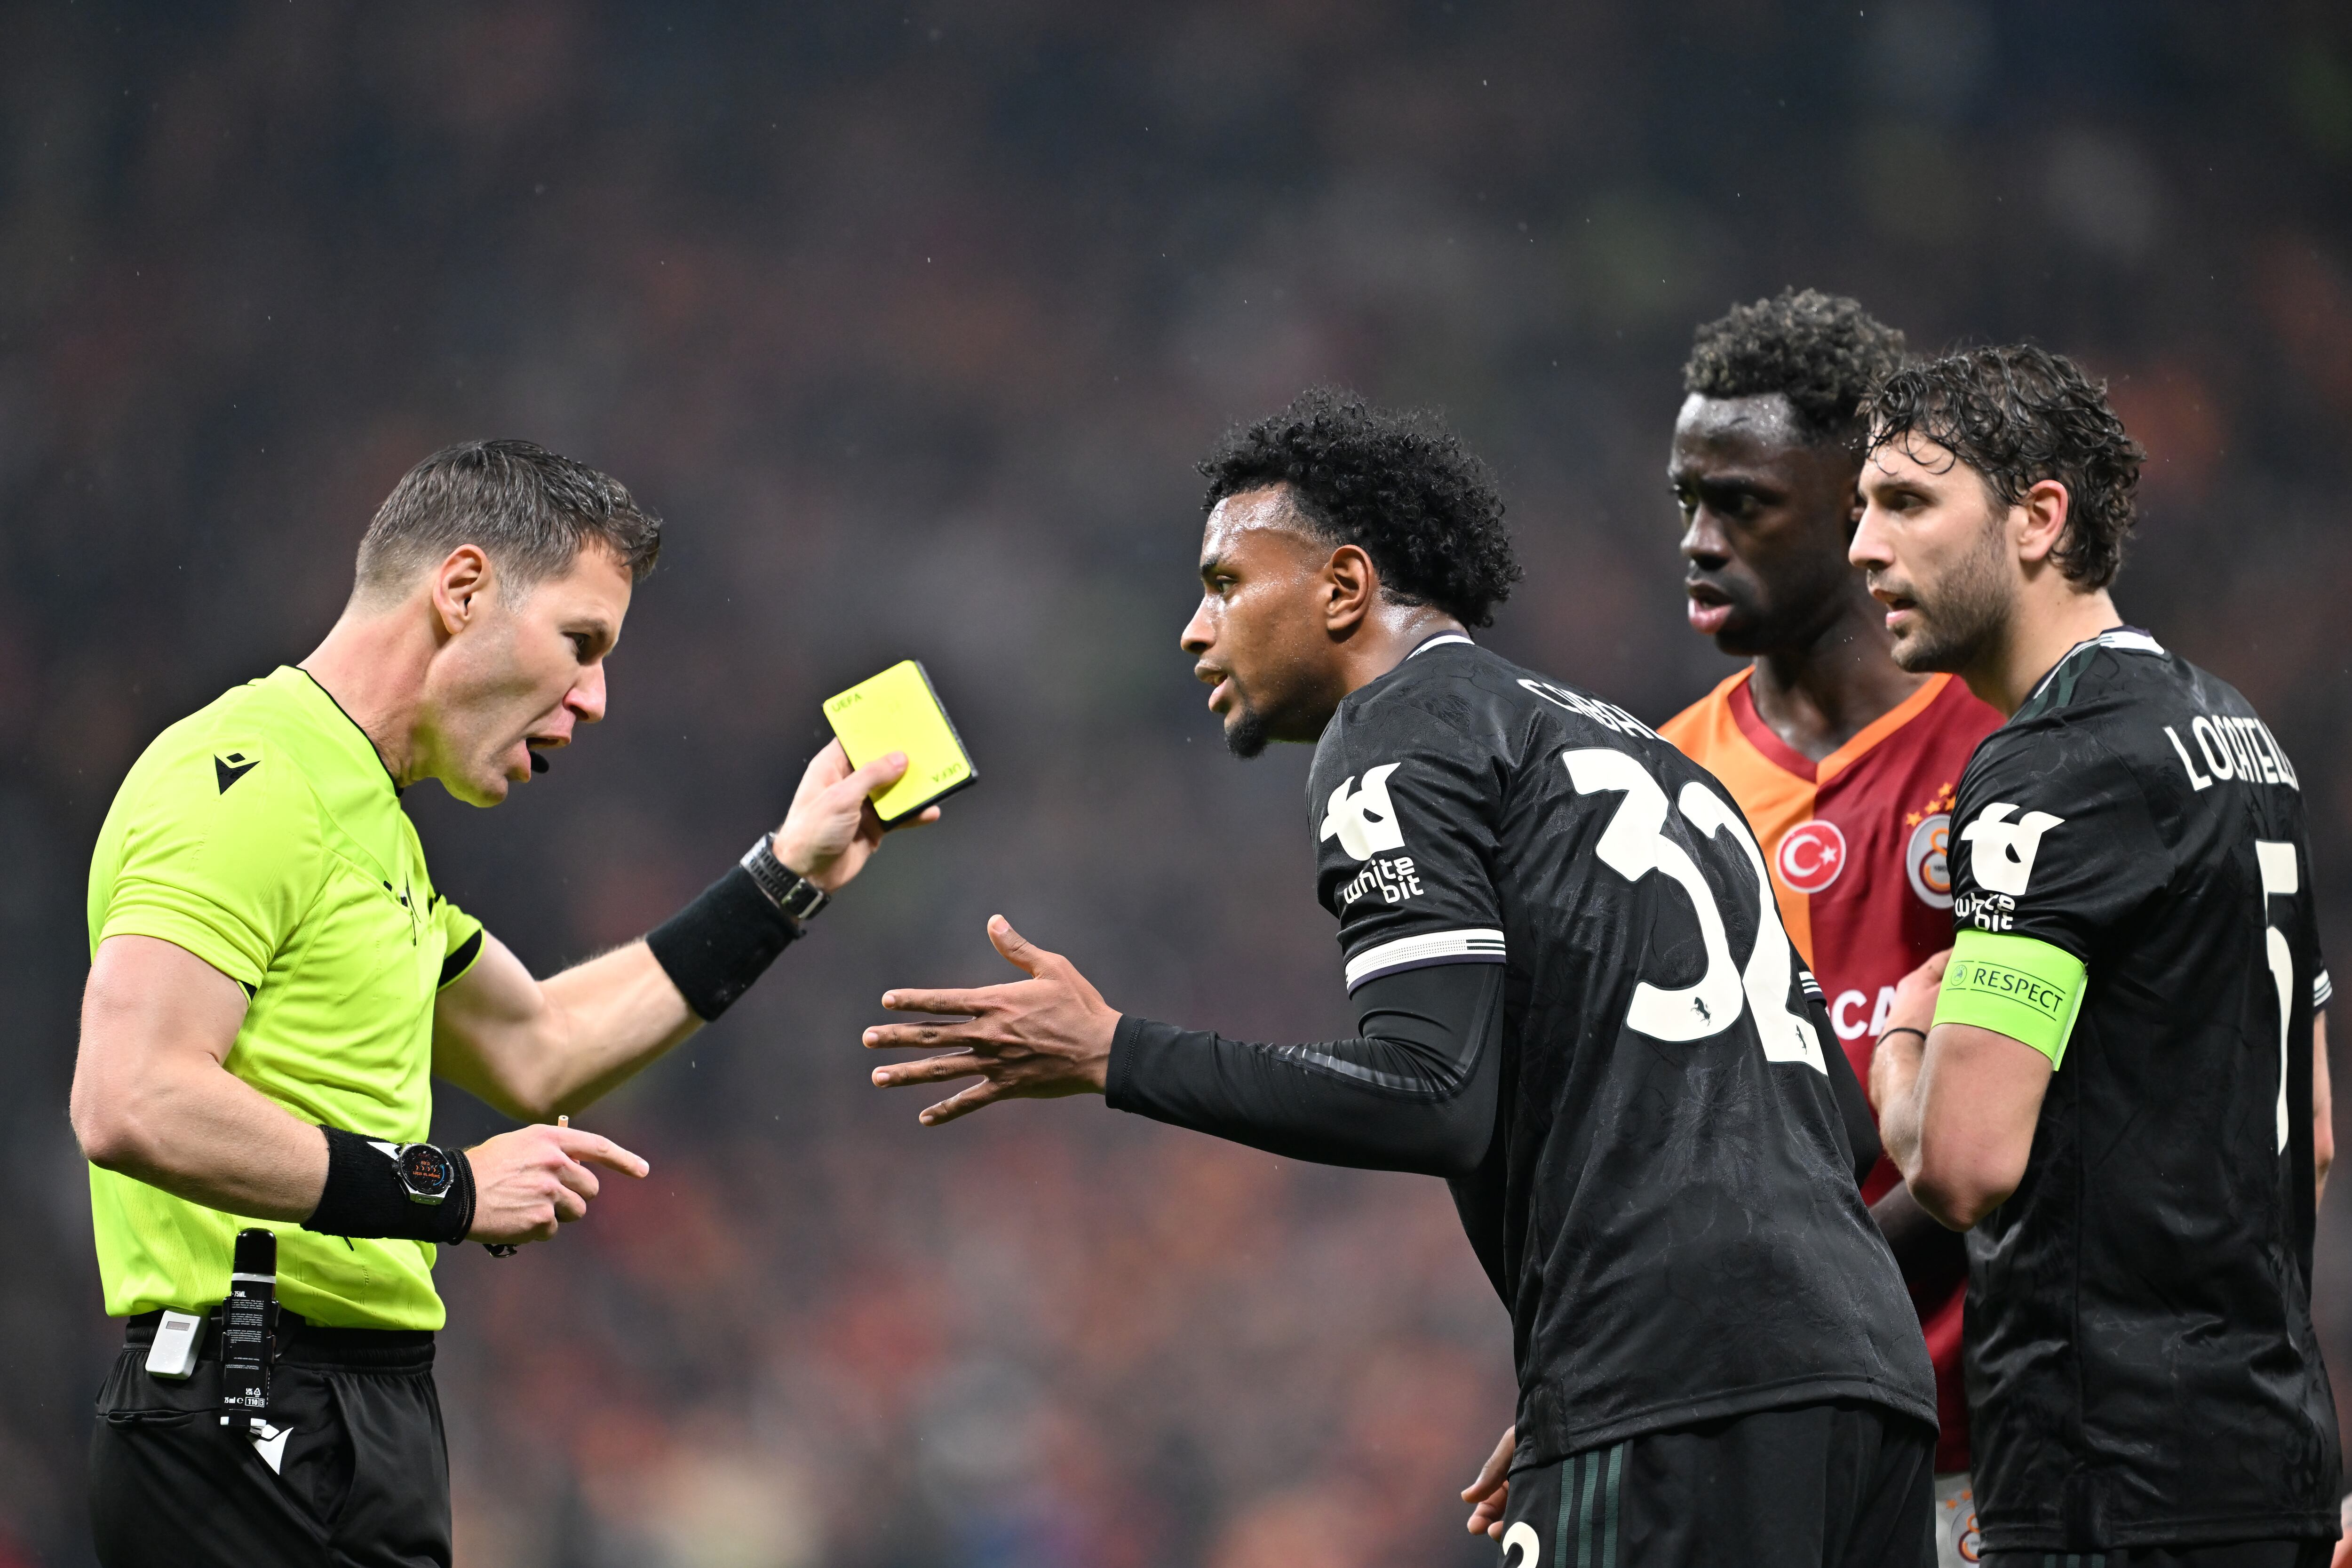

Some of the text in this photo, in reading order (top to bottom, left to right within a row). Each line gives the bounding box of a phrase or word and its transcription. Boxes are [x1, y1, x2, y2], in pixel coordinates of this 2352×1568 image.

[831, 693, 862, 712] UEFA
[931, 763, 962, 782] UEFA
[1343, 857, 1415, 904] white
[1382, 875, 1424, 903] bit
[1561, 747, 1829, 1078] 32
[1973, 968, 2063, 1013] RESPECT
